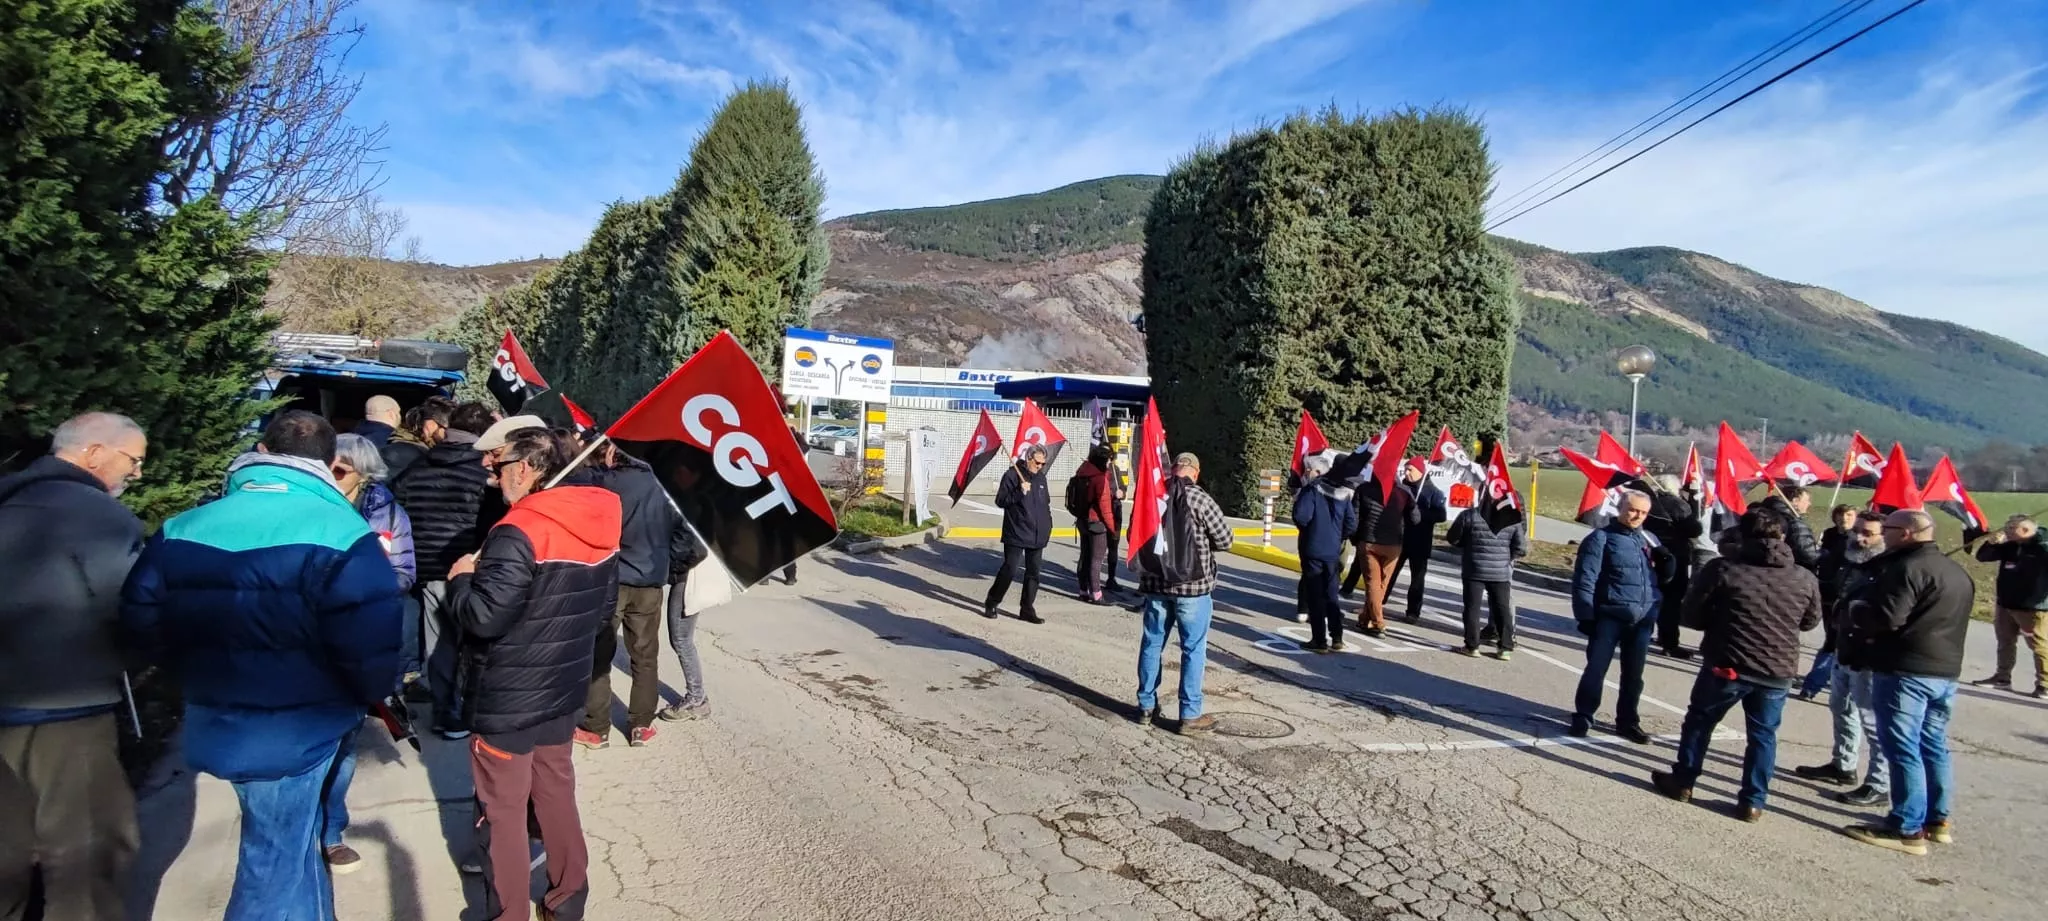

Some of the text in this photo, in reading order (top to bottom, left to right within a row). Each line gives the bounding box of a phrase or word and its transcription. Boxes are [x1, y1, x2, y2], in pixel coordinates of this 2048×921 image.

[493, 348, 526, 392] CGT
[958, 371, 1013, 382] Baxter
[681, 393, 798, 520] CGT
[1440, 440, 1487, 481] CGT
[1487, 464, 1517, 511] CGT
